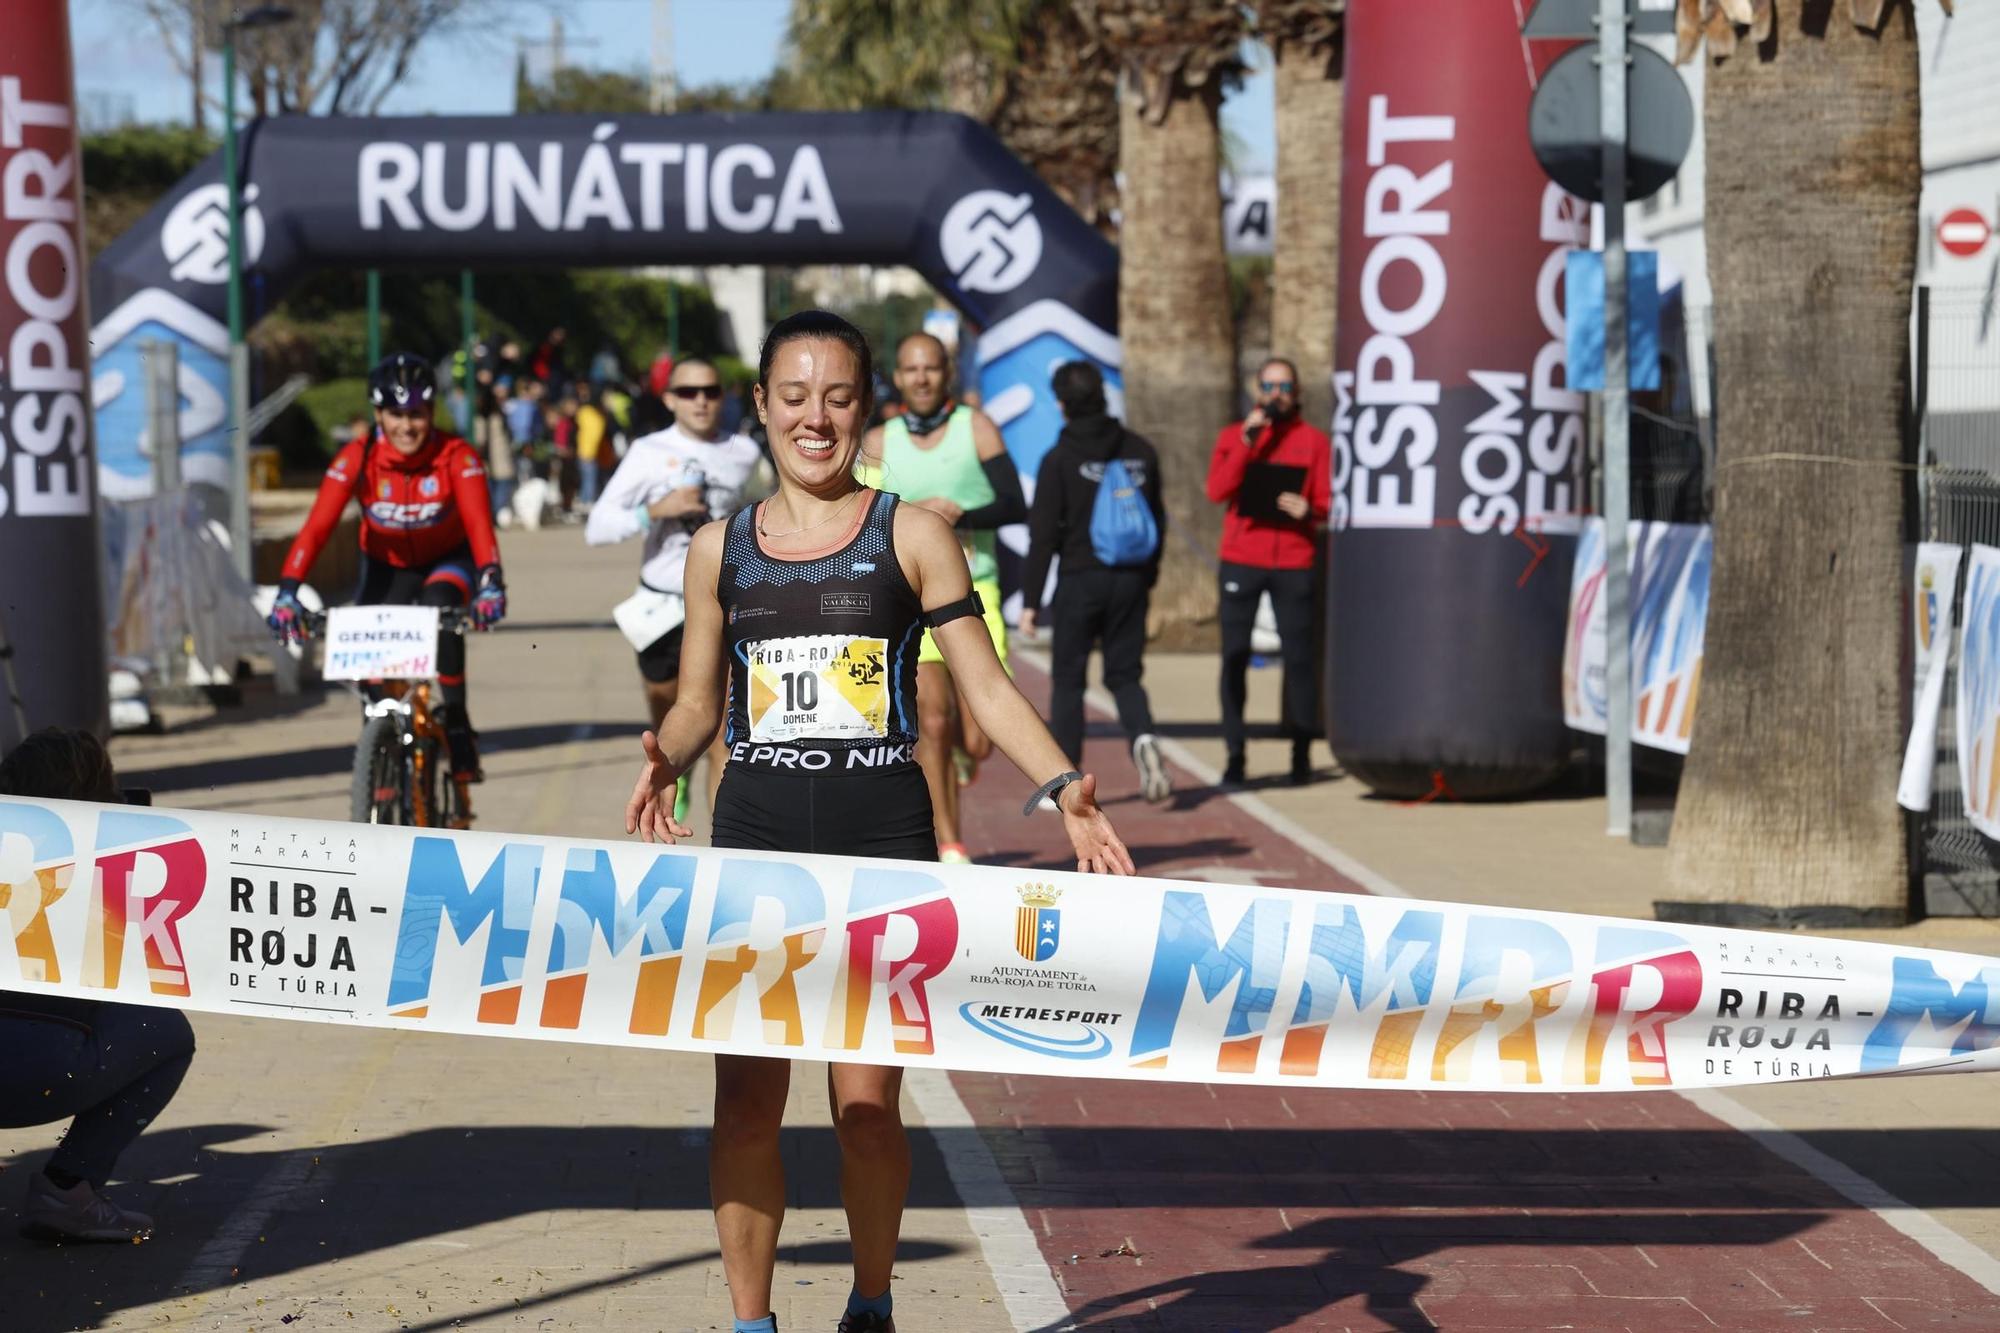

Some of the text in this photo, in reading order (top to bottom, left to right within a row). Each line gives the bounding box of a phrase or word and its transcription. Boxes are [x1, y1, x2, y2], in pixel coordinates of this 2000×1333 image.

[357, 122, 844, 234] RUNÁTICA
[2, 76, 91, 516] ESPORT
[1351, 94, 1456, 528] ESPORT
[1457, 369, 1527, 535] SOM
[339, 630, 424, 642] GENERAL
[782, 671, 818, 712] 10
[783, 713, 818, 725] DOMENE
[750, 746, 832, 770] PRO
[845, 743, 913, 769] NIKE
[231, 843, 357, 863] MARATÓ
[970, 975, 1097, 992] RIBA-ROJA DE TÚRIA
[992, 966, 1079, 981] AJUNTAMENT
[230, 973, 357, 997] DE TÚRIA
[981, 1005, 1122, 1025] METAESPORT
[1706, 1057, 1832, 1077] DE TÚRIA
